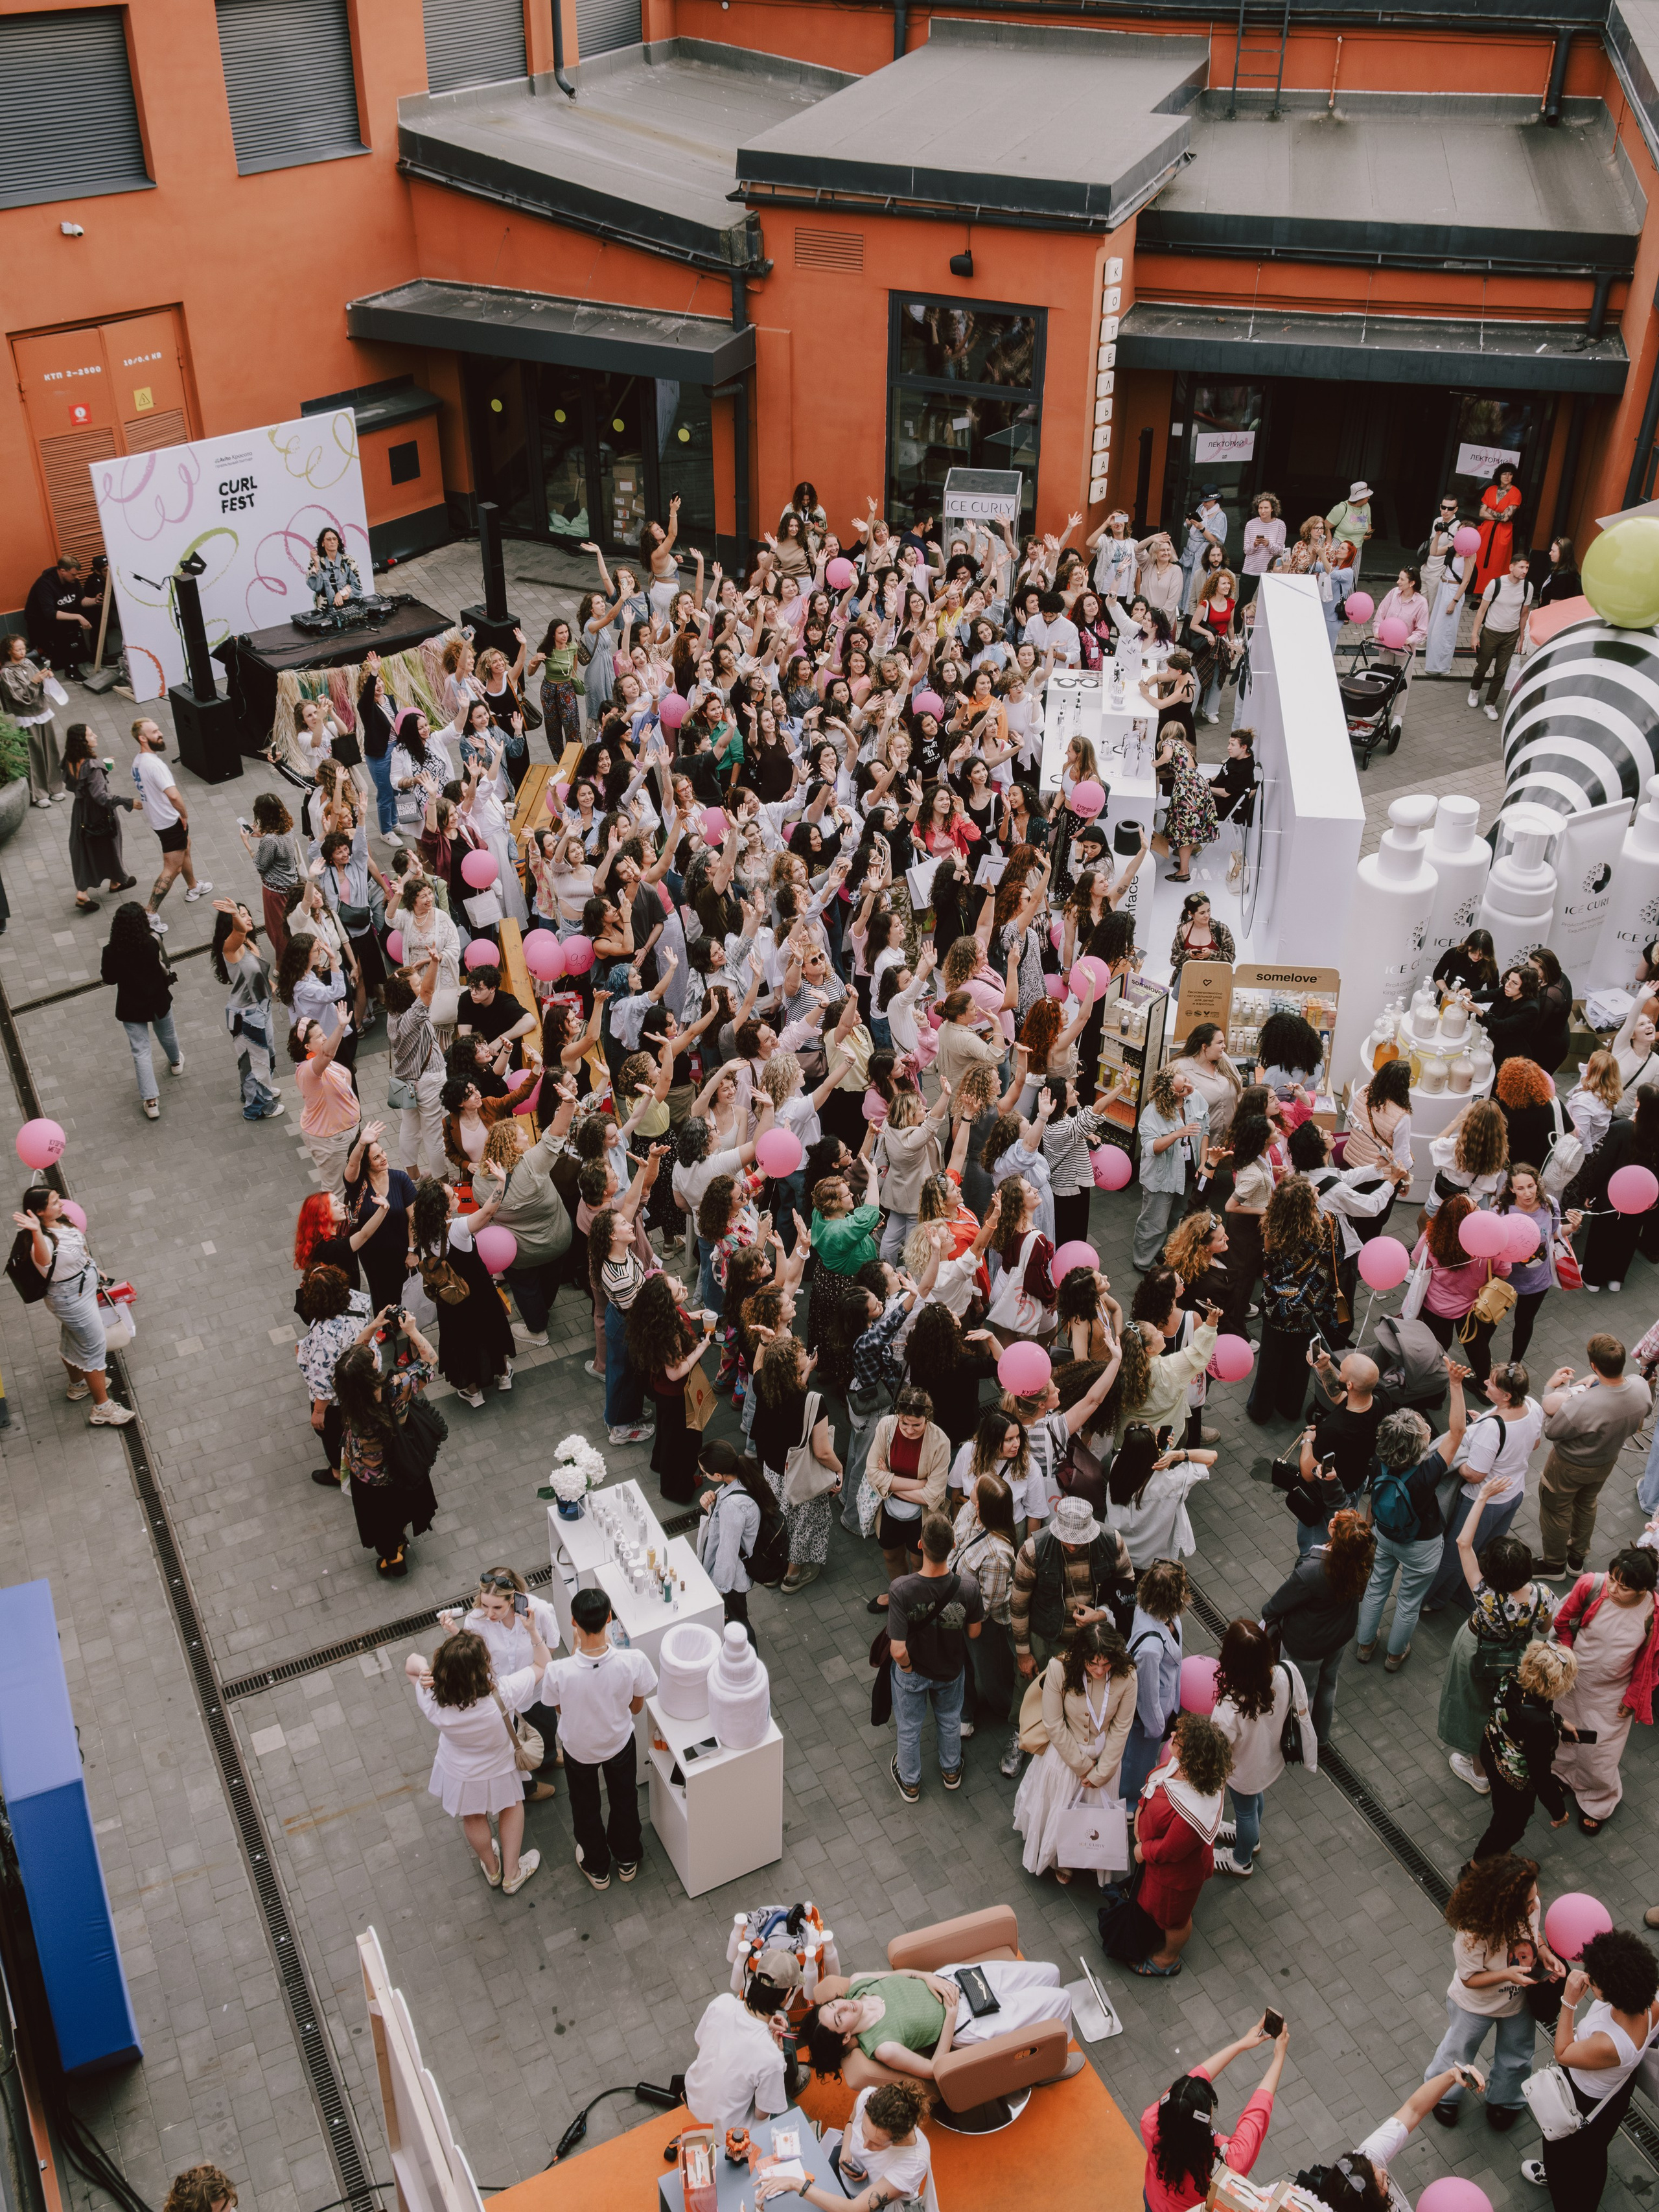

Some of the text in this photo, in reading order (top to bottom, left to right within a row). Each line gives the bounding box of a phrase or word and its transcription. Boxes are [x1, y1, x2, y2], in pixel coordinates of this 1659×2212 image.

[43, 366, 101, 381] КТП 2-2500
[1099, 267, 1119, 496] КОТЕЛЬНАЯ
[1207, 439, 1245, 448] ЛЕКТОРИЙ
[219, 476, 257, 496] CURL
[222, 493, 254, 513] FEST
[947, 500, 1014, 514] ICE CURLY
[927, 749, 935, 758] 01
[396, 803, 417, 812] BRAZILIAN
[398, 808, 417, 817] BLOWOUT
[1565, 905, 1585, 915] ICE
[1617, 931, 1642, 943] ICE
[1433, 938, 1456, 948] ICE
[568, 953, 593, 969] 926
[1385, 964, 1408, 975] ICE
[1256, 973, 1317, 984] somelove
[1131, 979, 1163, 996] somelove
